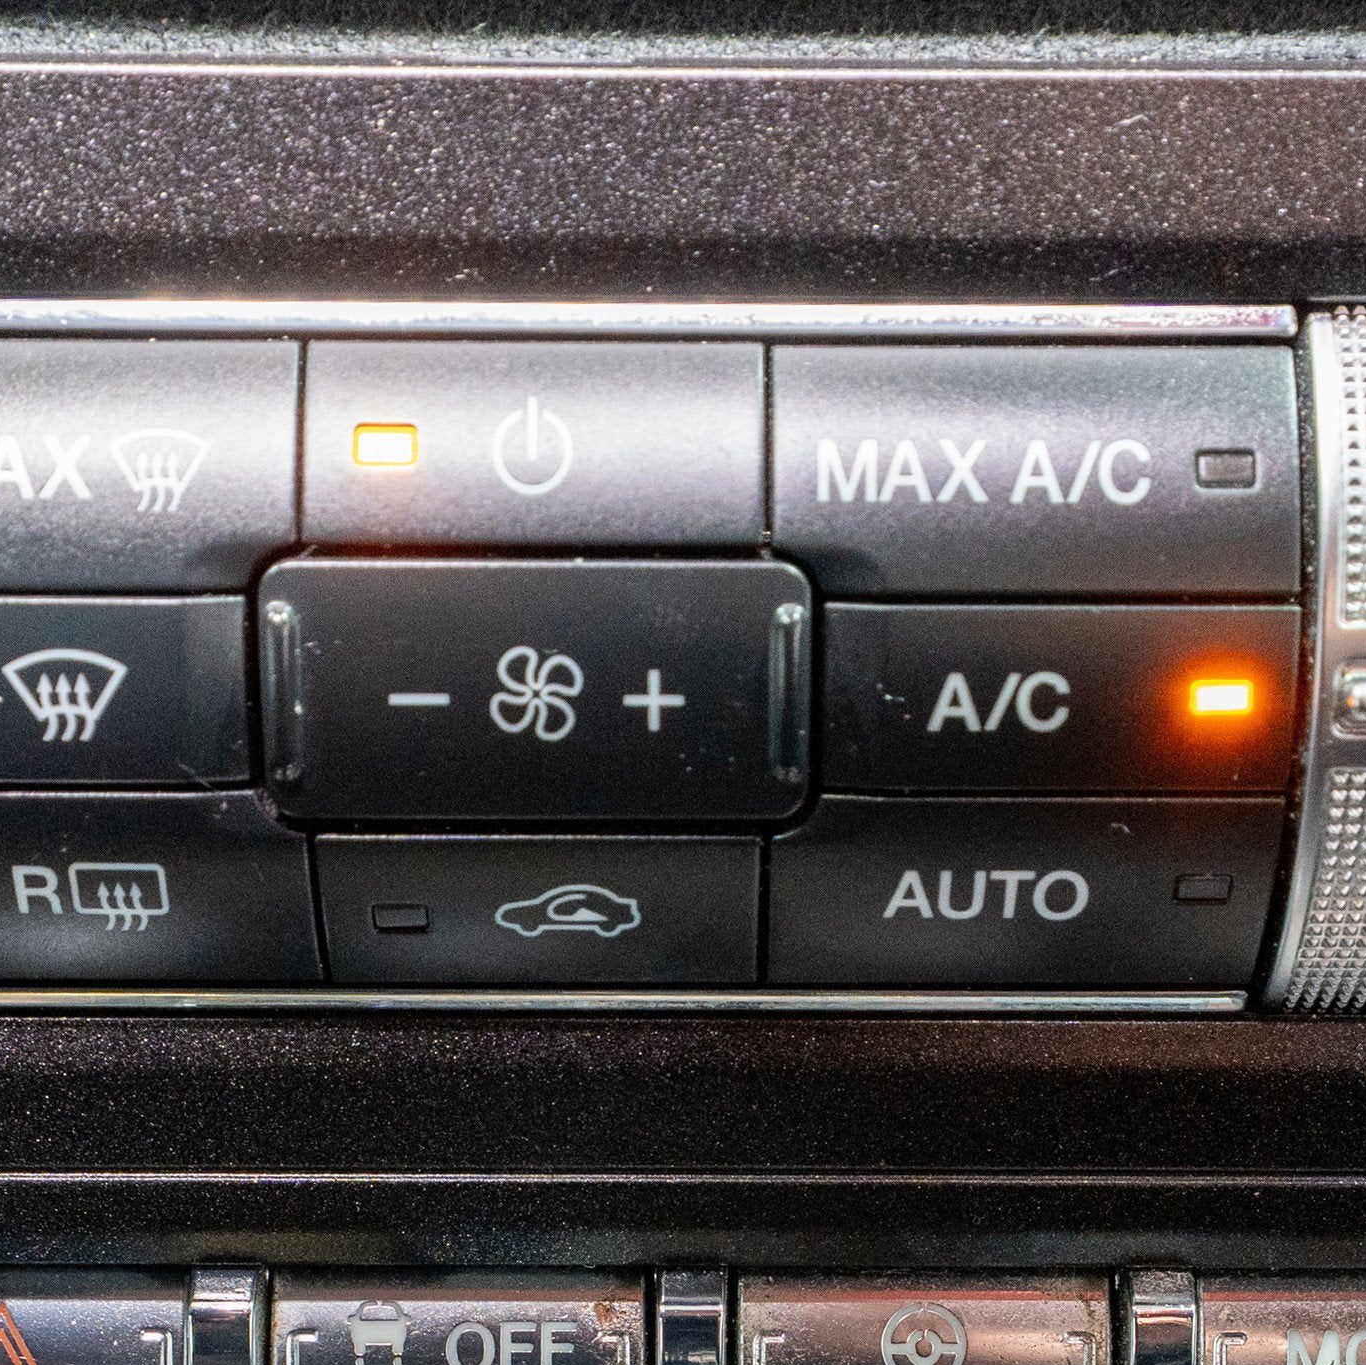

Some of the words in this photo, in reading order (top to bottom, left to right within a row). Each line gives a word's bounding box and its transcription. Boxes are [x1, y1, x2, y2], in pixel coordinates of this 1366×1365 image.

[816, 437, 989, 502] MAX
[1012, 440, 1152, 505] A/C
[927, 670, 1070, 732] A/C
[13, 864, 60, 914] R
[884, 870, 1090, 921] AUTO
